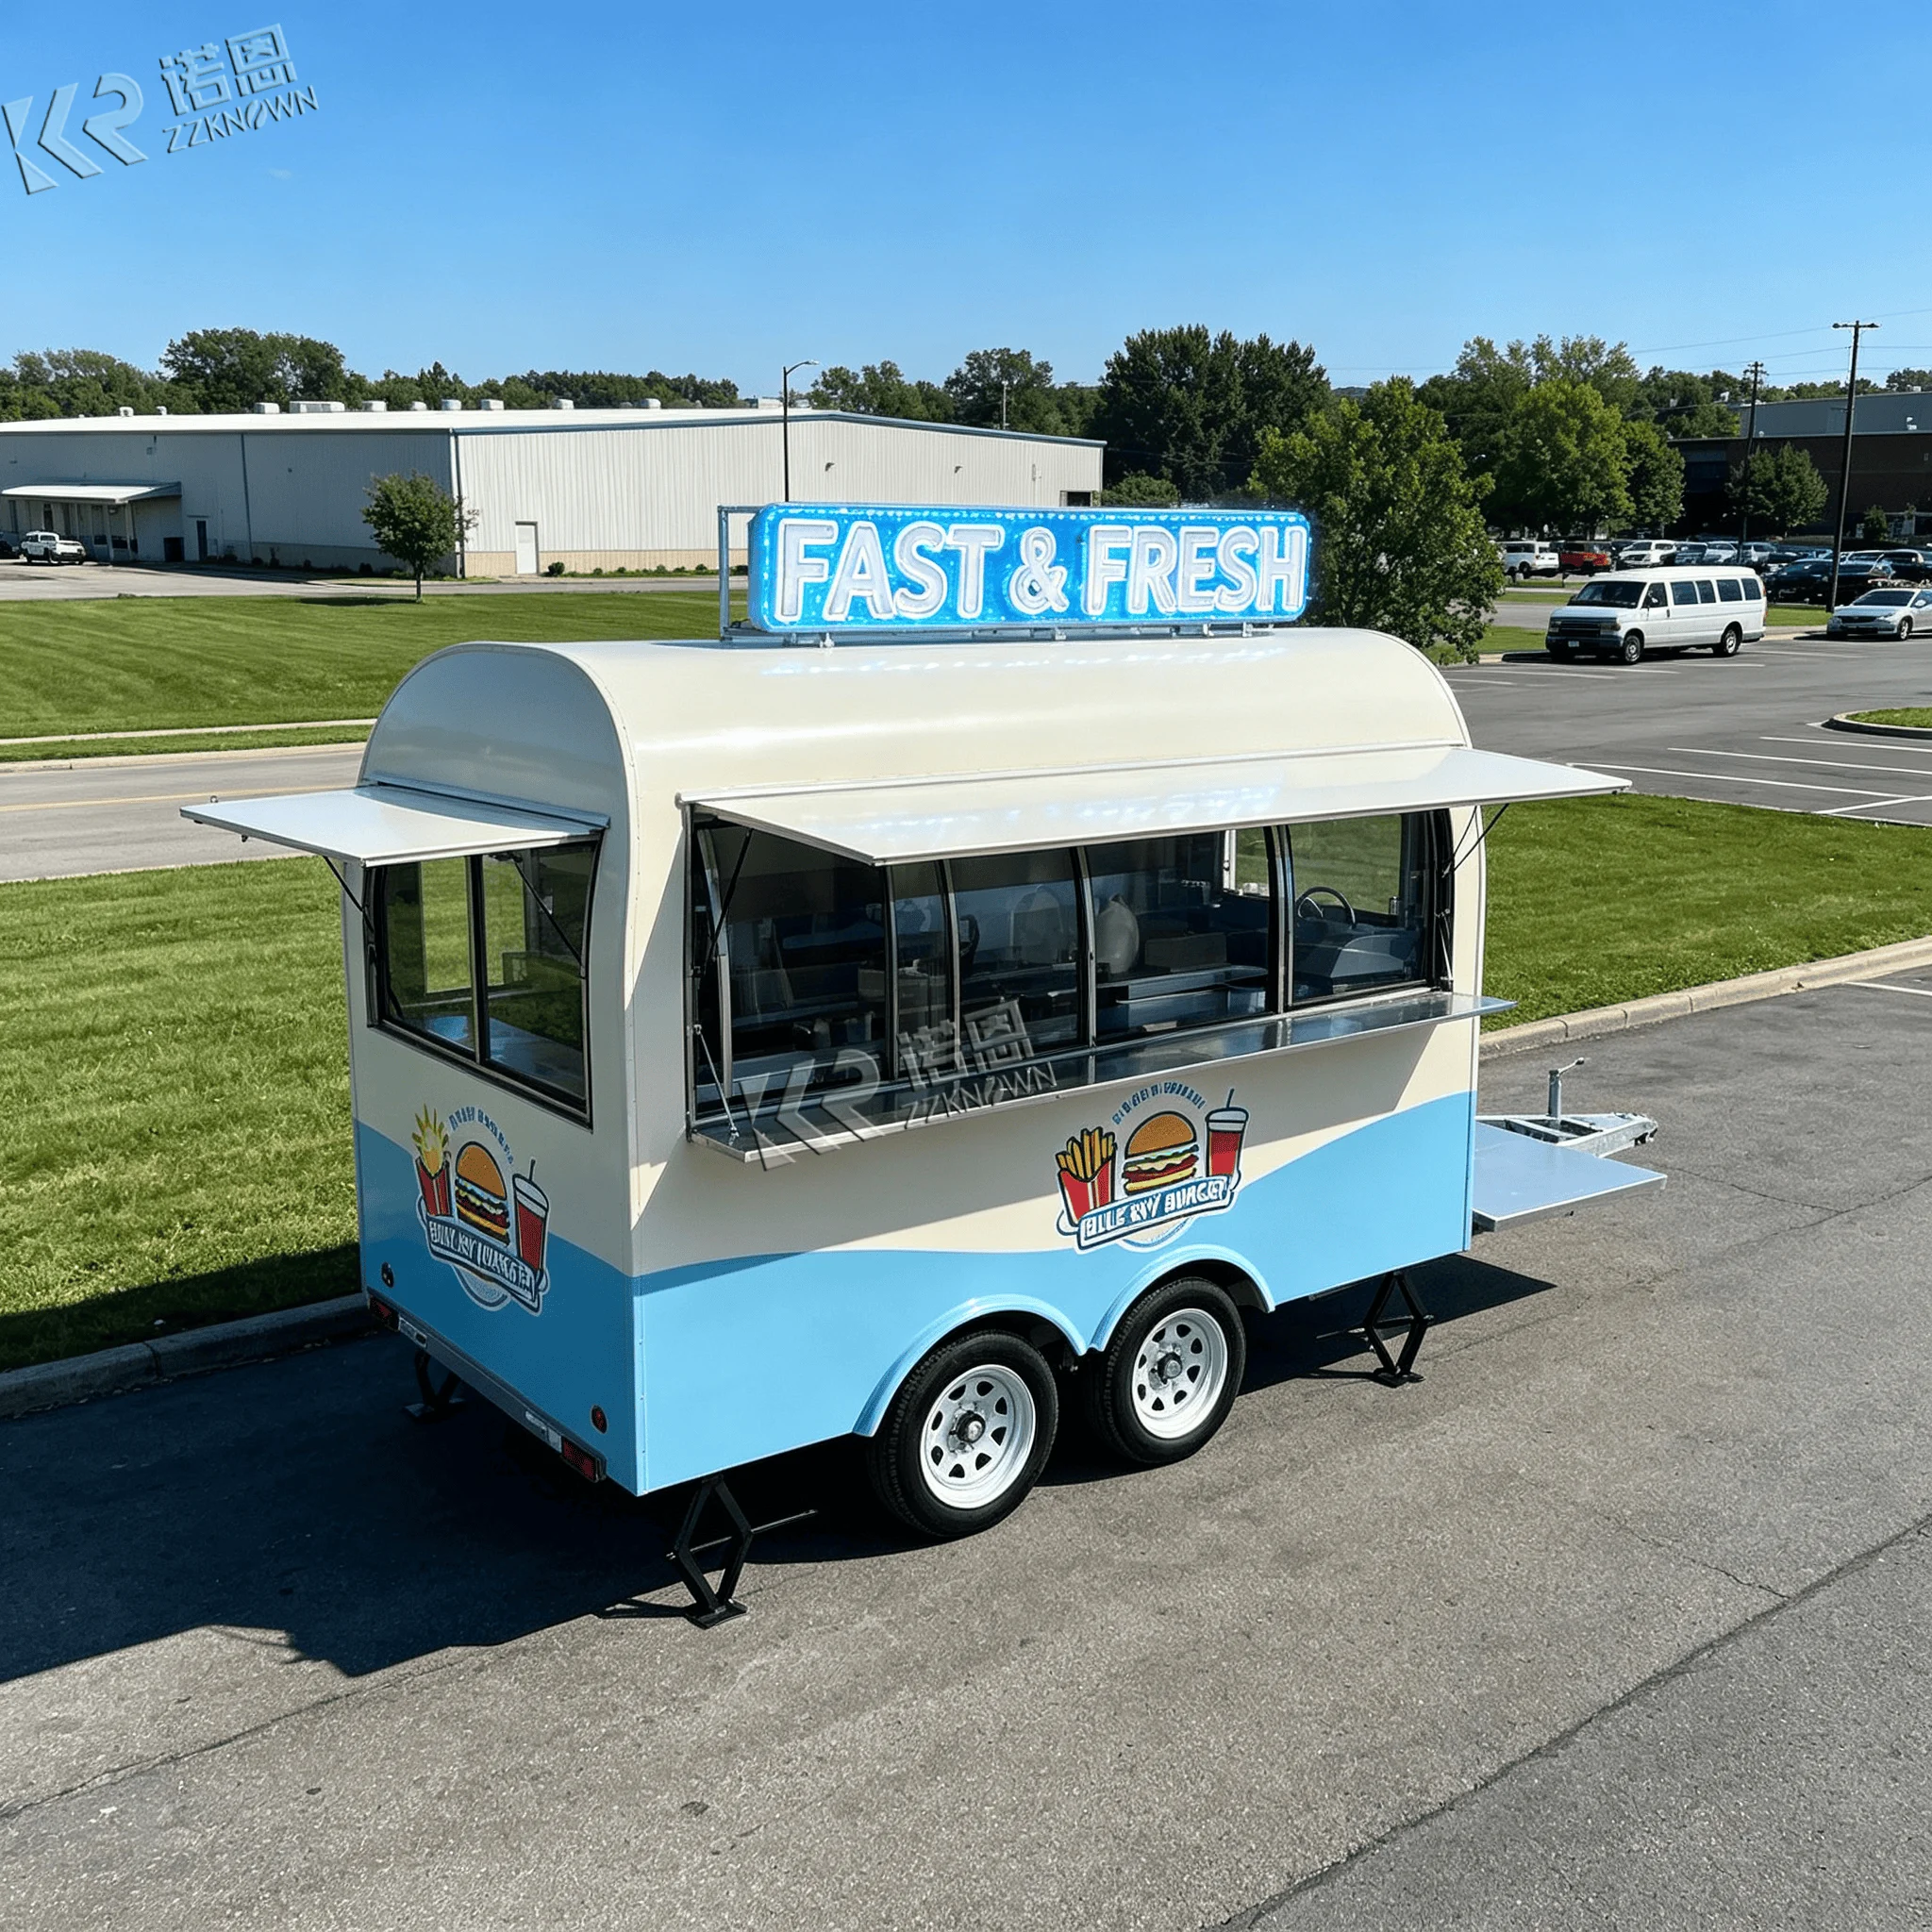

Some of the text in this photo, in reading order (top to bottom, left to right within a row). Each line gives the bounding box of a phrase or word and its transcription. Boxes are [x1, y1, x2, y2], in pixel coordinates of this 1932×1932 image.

[774, 517, 1307, 623] FAST & FRESH
